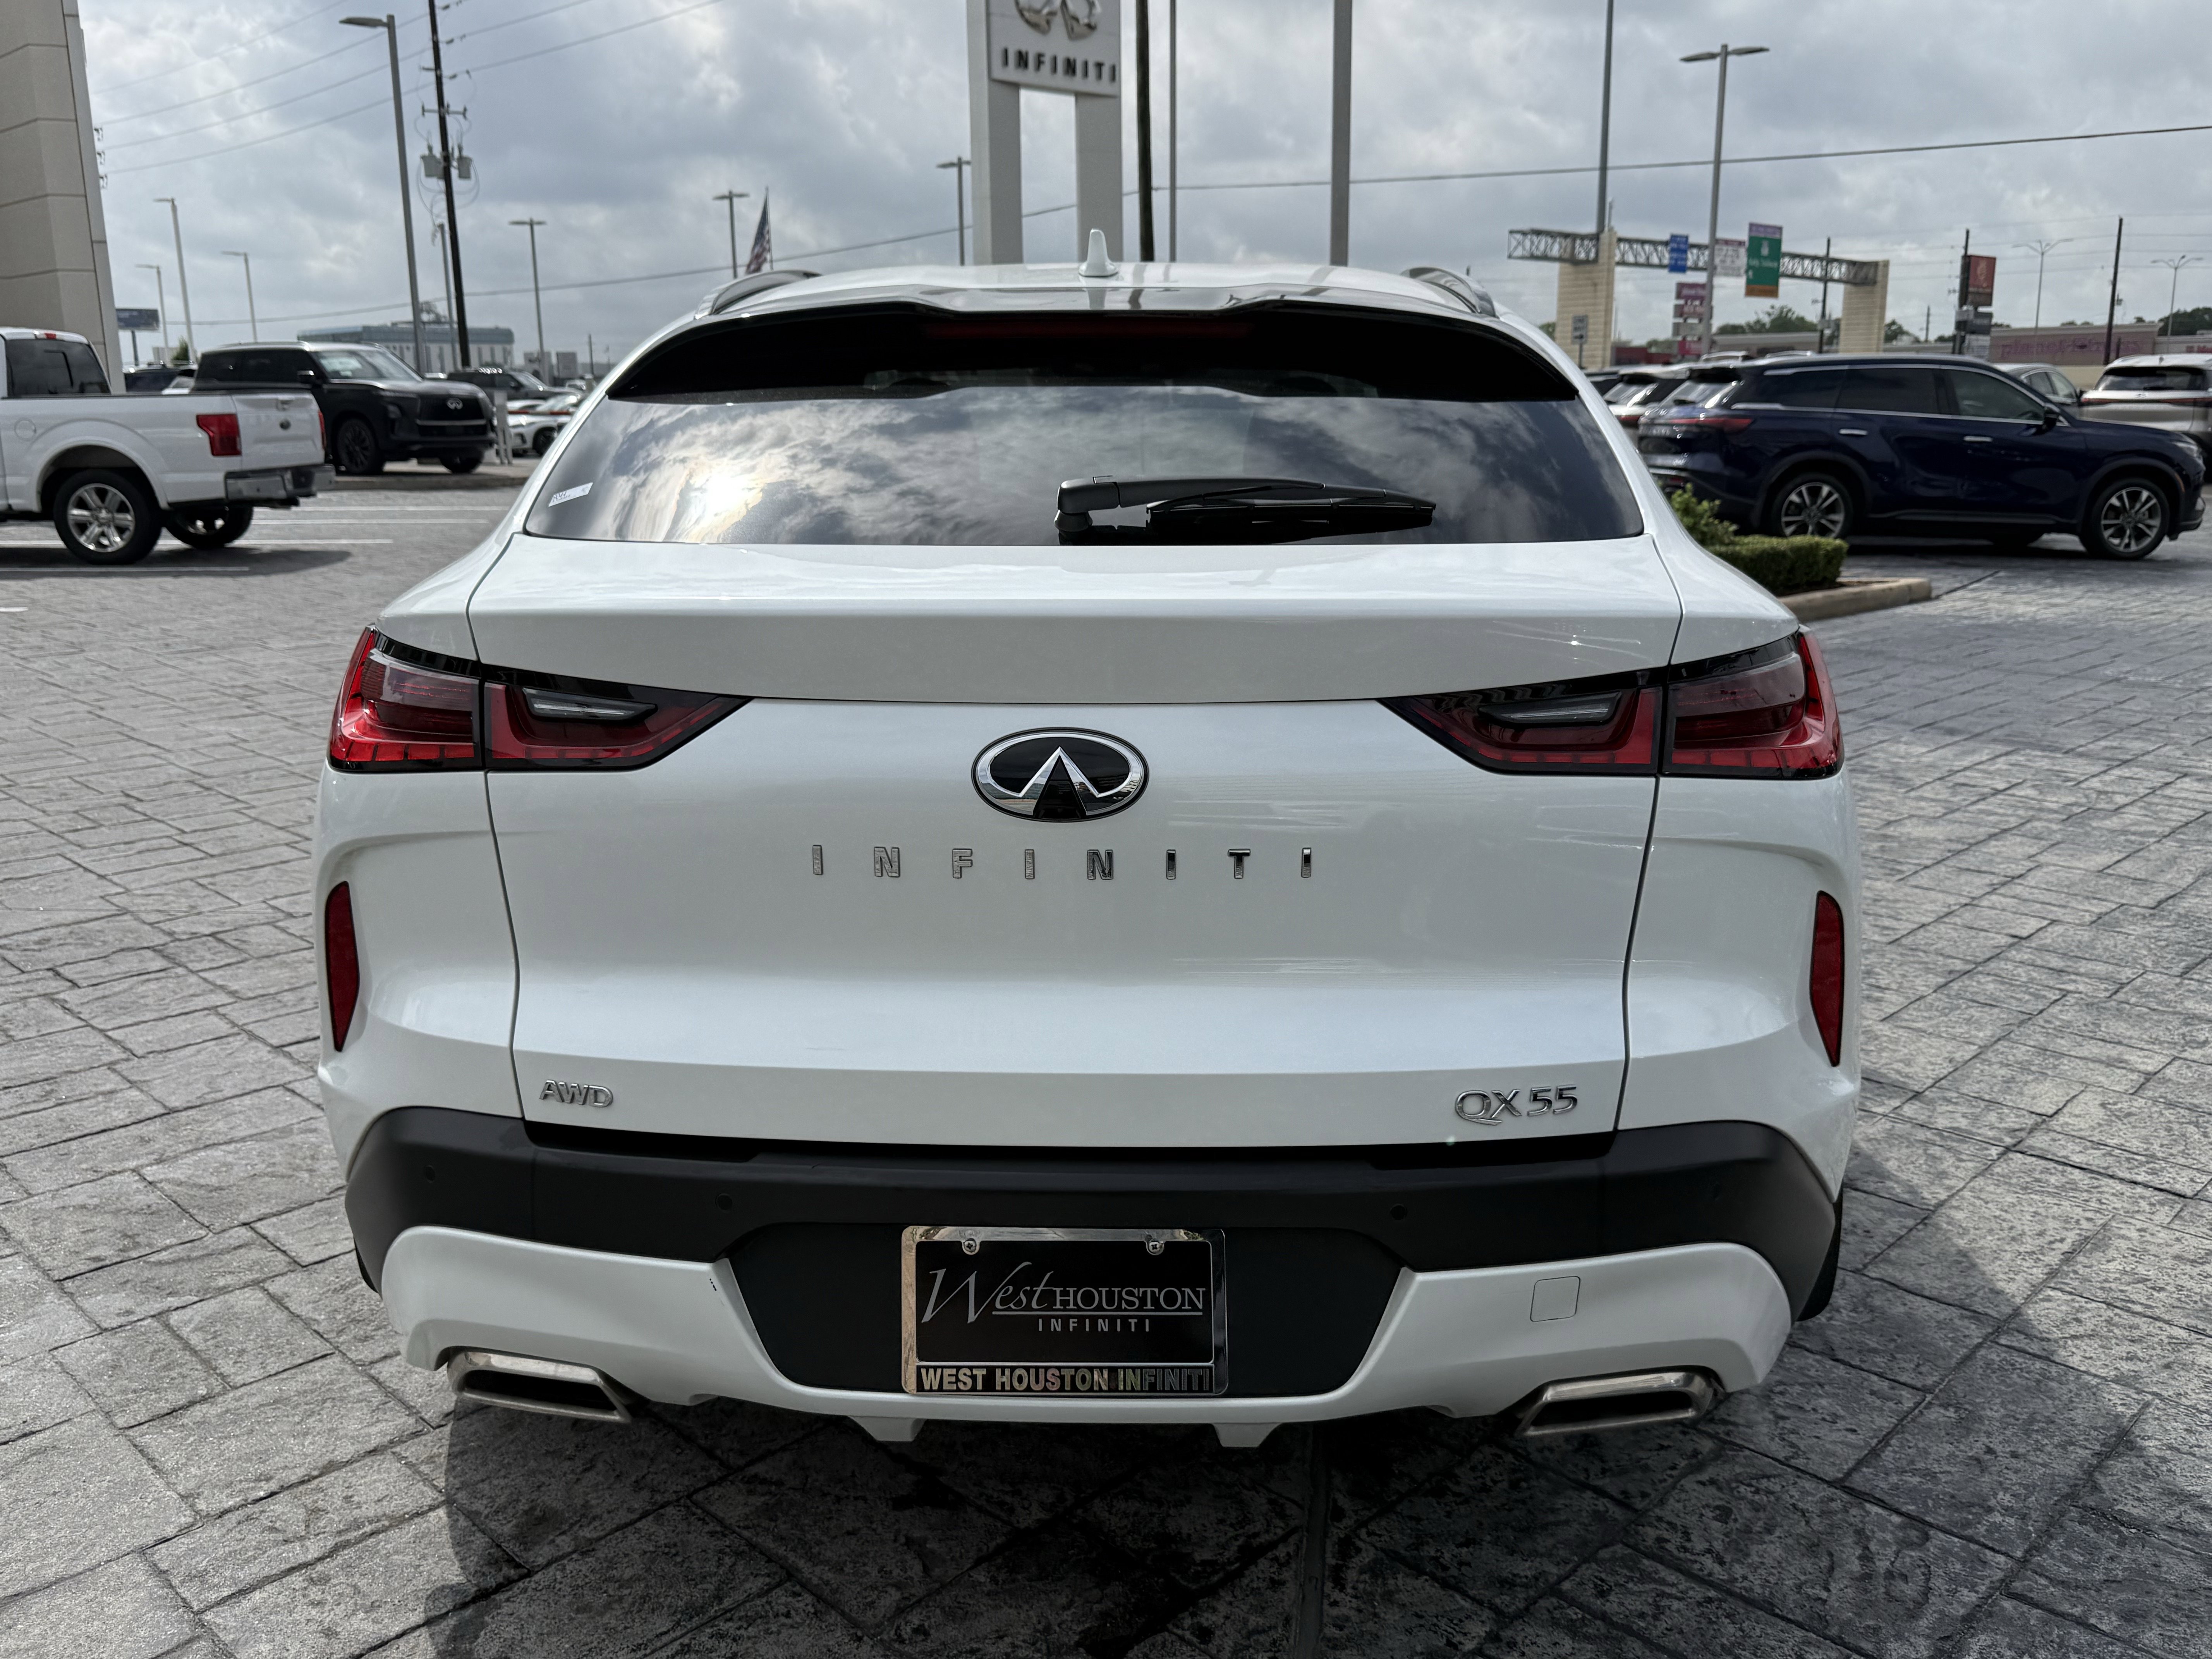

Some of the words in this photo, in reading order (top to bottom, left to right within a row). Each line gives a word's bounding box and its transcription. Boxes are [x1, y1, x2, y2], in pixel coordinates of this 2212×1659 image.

[1002, 48, 1116, 82] INFINITI
[811, 844, 1313, 880] INFINITI
[539, 1079, 613, 1108] AWD
[921, 1261, 1055, 1324] West
[1053, 1287, 1206, 1310] HOUSTON
[1038, 1318, 1150, 1332] INFINITI
[921, 1368, 987, 1391] WEST
[995, 1368, 1109, 1391] HOUSTON
[1118, 1368, 1210, 1392] INFINITI
